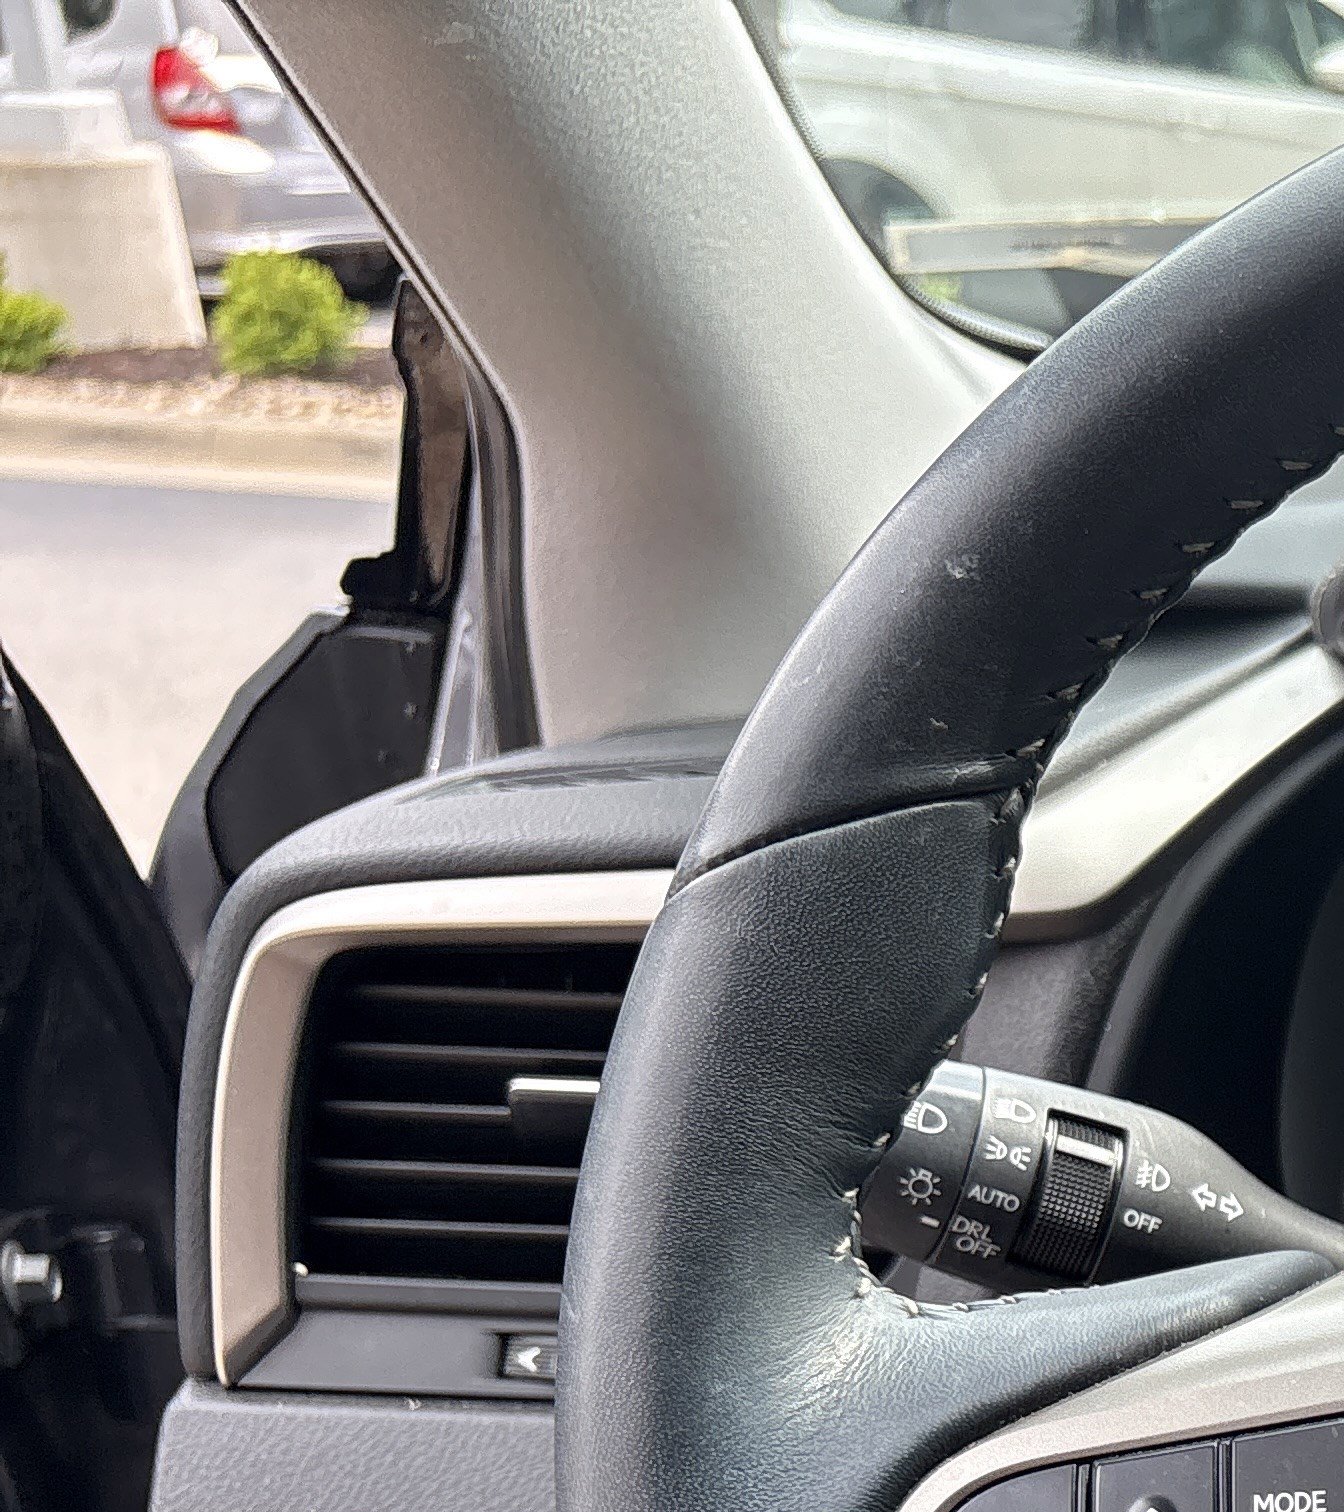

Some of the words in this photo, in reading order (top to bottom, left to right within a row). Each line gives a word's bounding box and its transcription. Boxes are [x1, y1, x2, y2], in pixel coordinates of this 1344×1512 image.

[968, 1185, 1021, 1213] AUTO
[952, 1214, 992, 1242] DRL
[1123, 1208, 1163, 1234] OFF
[956, 1236, 1001, 1260] OFF
